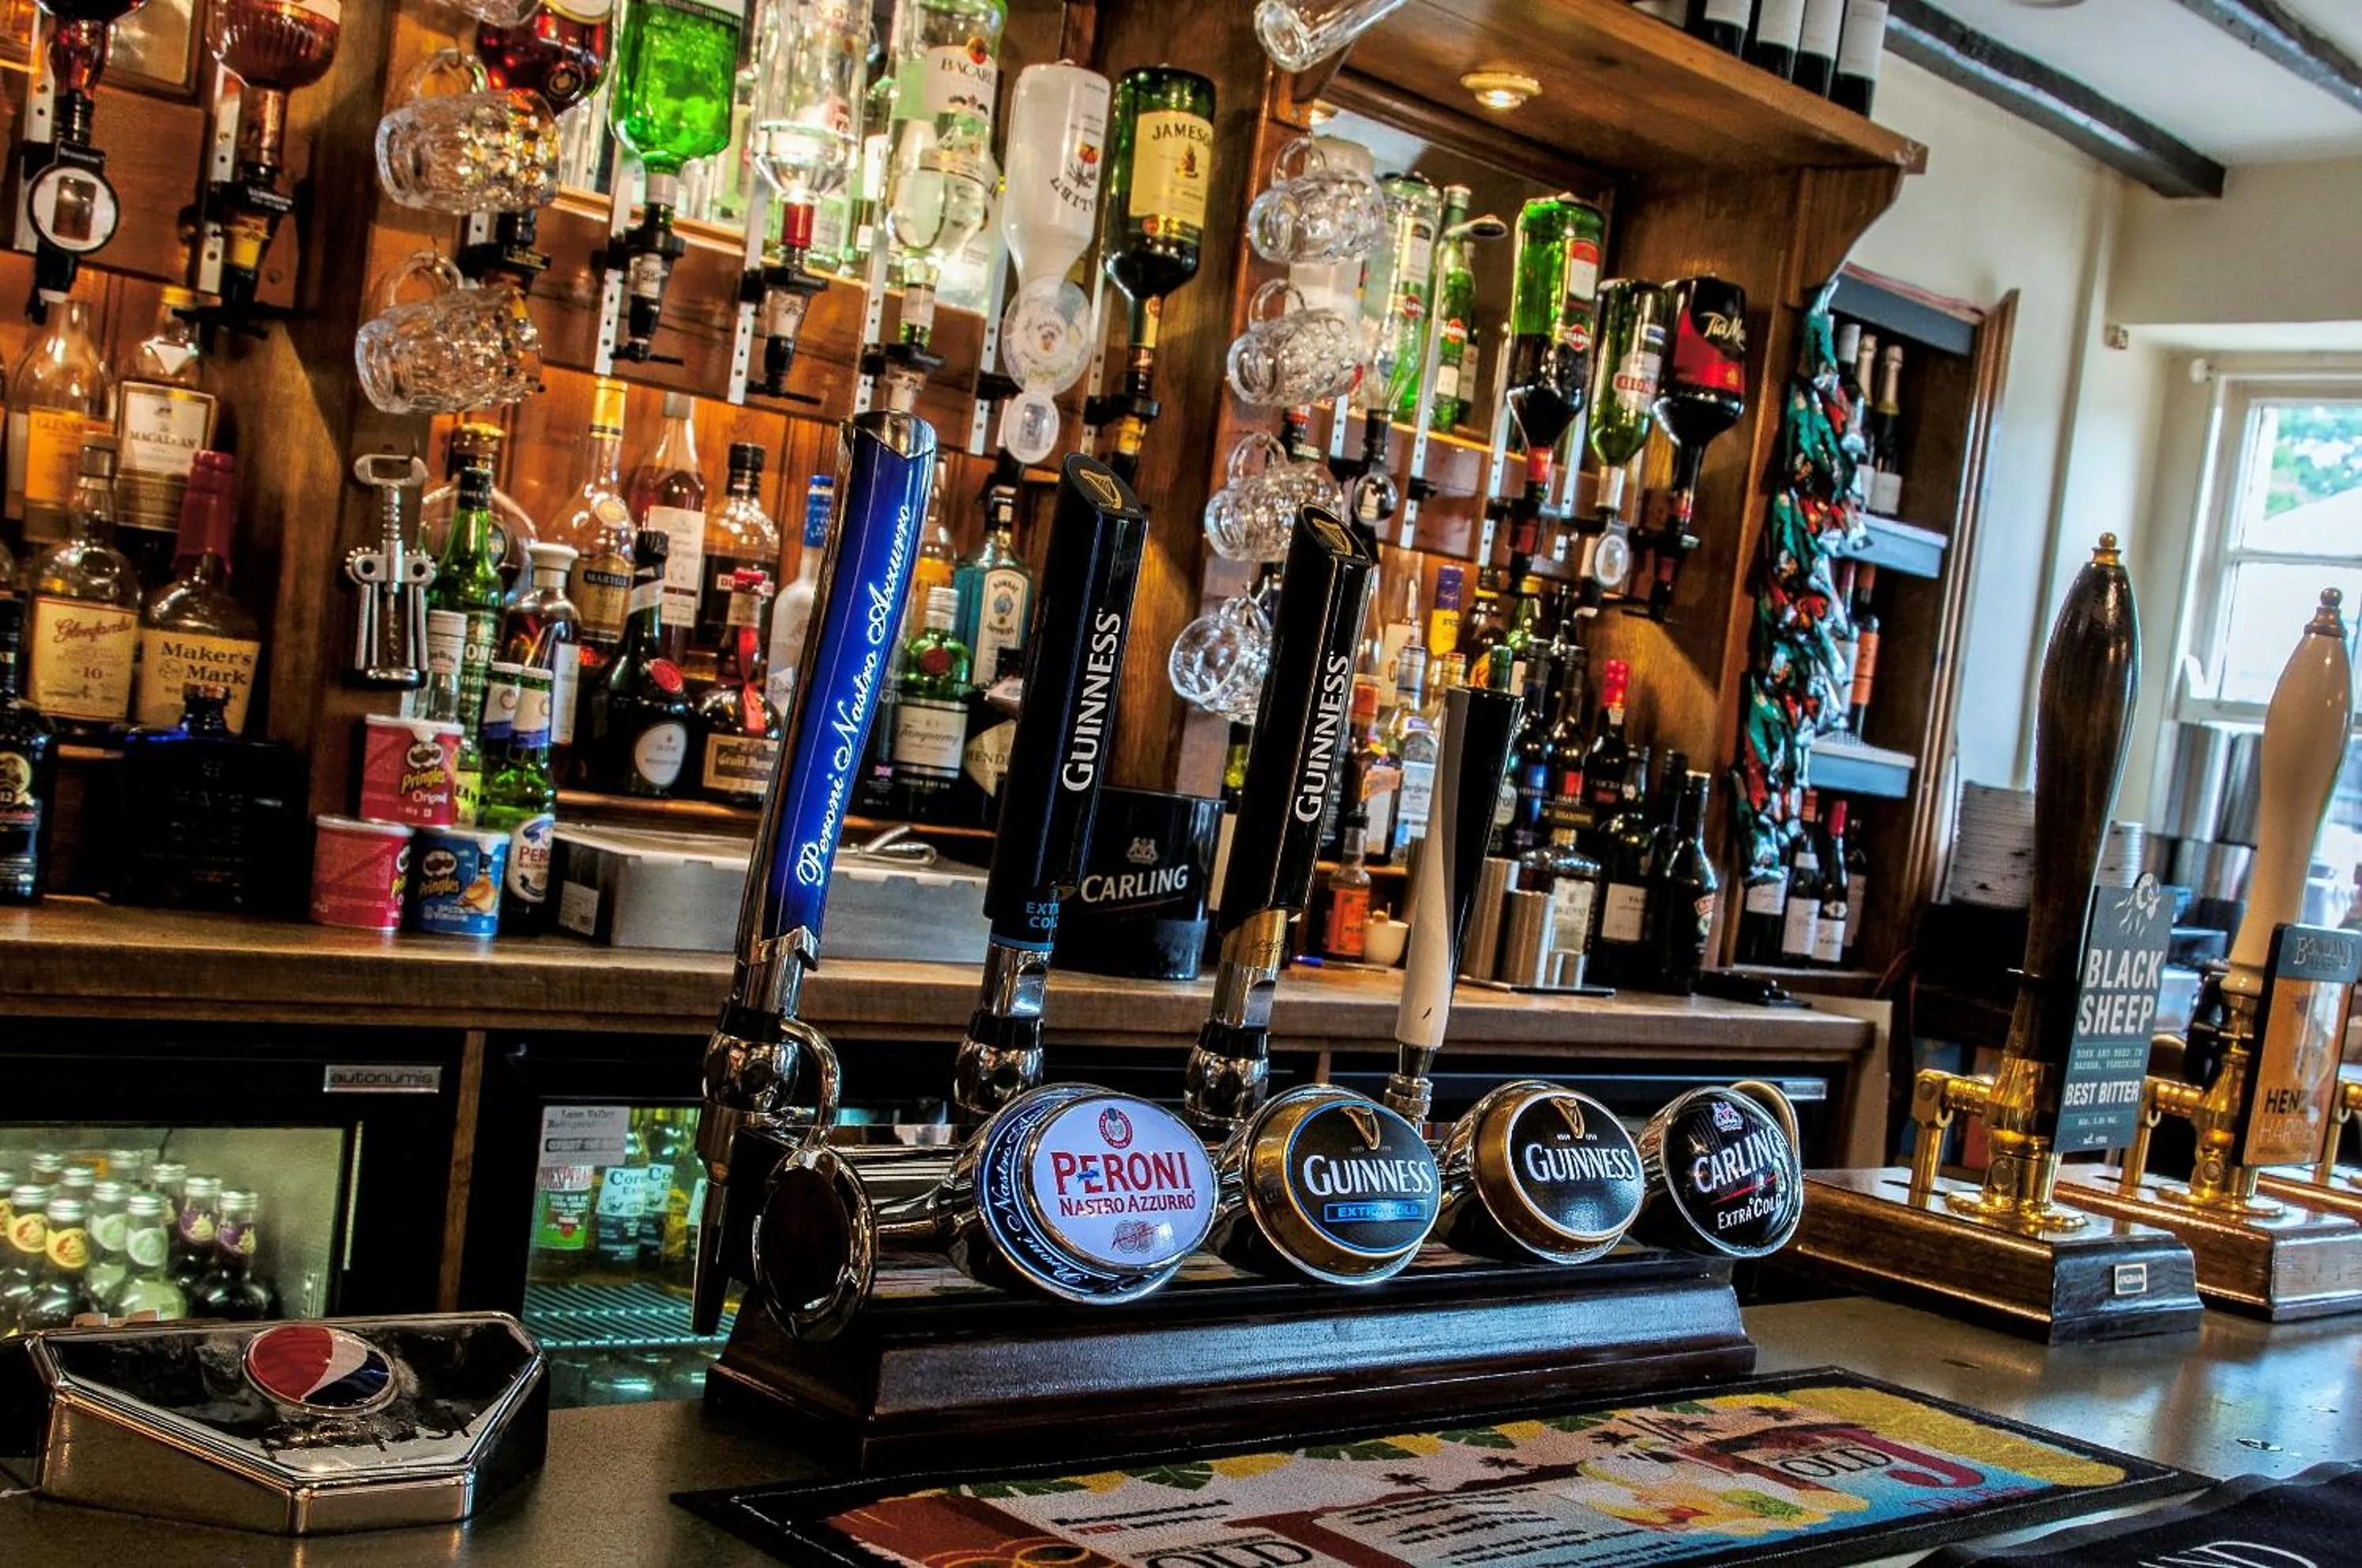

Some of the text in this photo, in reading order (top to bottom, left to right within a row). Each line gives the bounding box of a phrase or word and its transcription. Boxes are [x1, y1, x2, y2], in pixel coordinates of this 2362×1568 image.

[1152, 122, 1213, 147] JAMESO
[868, 503, 911, 644] Azzurro
[161, 641, 253, 666] Maker's
[82, 667, 103, 680] 10
[185, 664, 248, 686] Mark
[835, 649, 878, 772] Nastro
[1062, 611, 1121, 791] GUINNESS
[1294, 655, 1348, 823] GUINNESS
[796, 773, 844, 886] Peroni
[518, 845, 549, 863] PER
[1081, 864, 1189, 903] CARLING
[1029, 916, 1057, 929] COL
[2086, 949, 2165, 988] BLACK
[2078, 995, 2155, 1035] SHEEP
[329, 1070, 434, 1085] autonumis
[2064, 1081, 2141, 1106] BEST BITTER
[1051, 1151, 1192, 1195] PERONI
[1303, 1154, 1433, 1196] GUINNESS
[1525, 1142, 1636, 1183] GUINNESS
[1693, 1125, 1788, 1194] CARLING
[991, 1147, 1024, 1232] Nastro
[1059, 1193, 1197, 1216] NASTRO AZZURRO
[1337, 1205, 1419, 1218] EXTRA COLD
[1717, 1202, 1755, 1230] EXTRA
[1780, 1447, 1893, 1478] OLD
